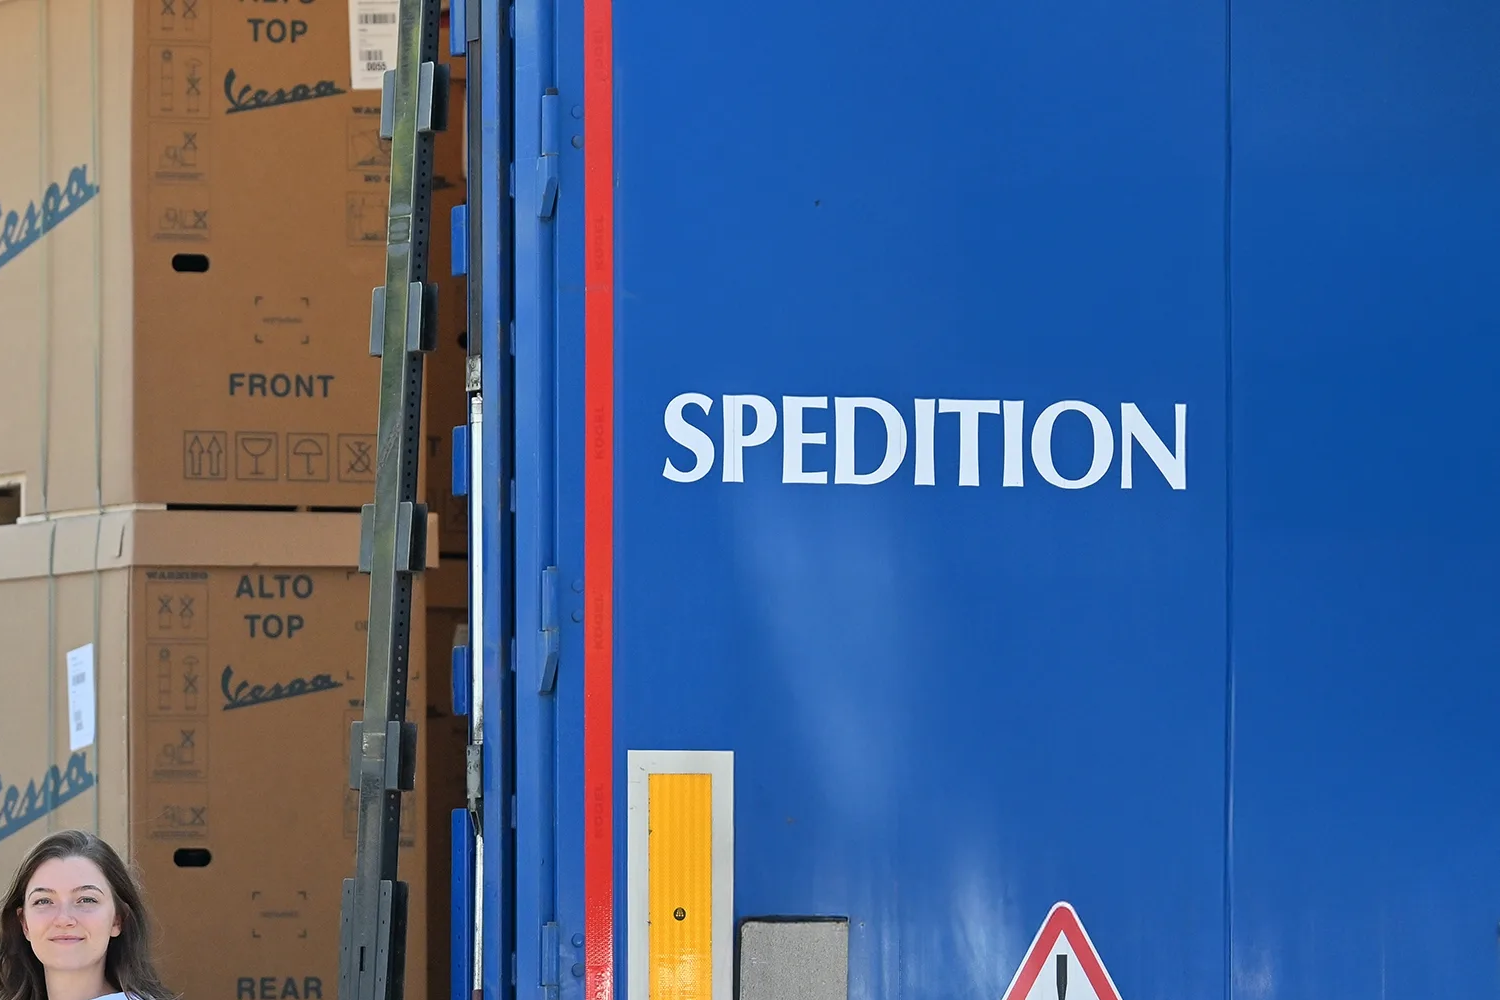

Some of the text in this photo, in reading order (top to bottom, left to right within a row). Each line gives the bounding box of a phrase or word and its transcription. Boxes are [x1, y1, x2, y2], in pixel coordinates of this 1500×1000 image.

[246, 18, 308, 43] TOP
[223, 68, 347, 115] Vespa
[229, 373, 335, 398] FRONT
[662, 392, 1187, 490] SPEDITION
[235, 574, 314, 599] ALTO
[244, 614, 305, 640] TOP
[221, 664, 343, 711] Vespa
[237, 976, 323, 1000] REAR
